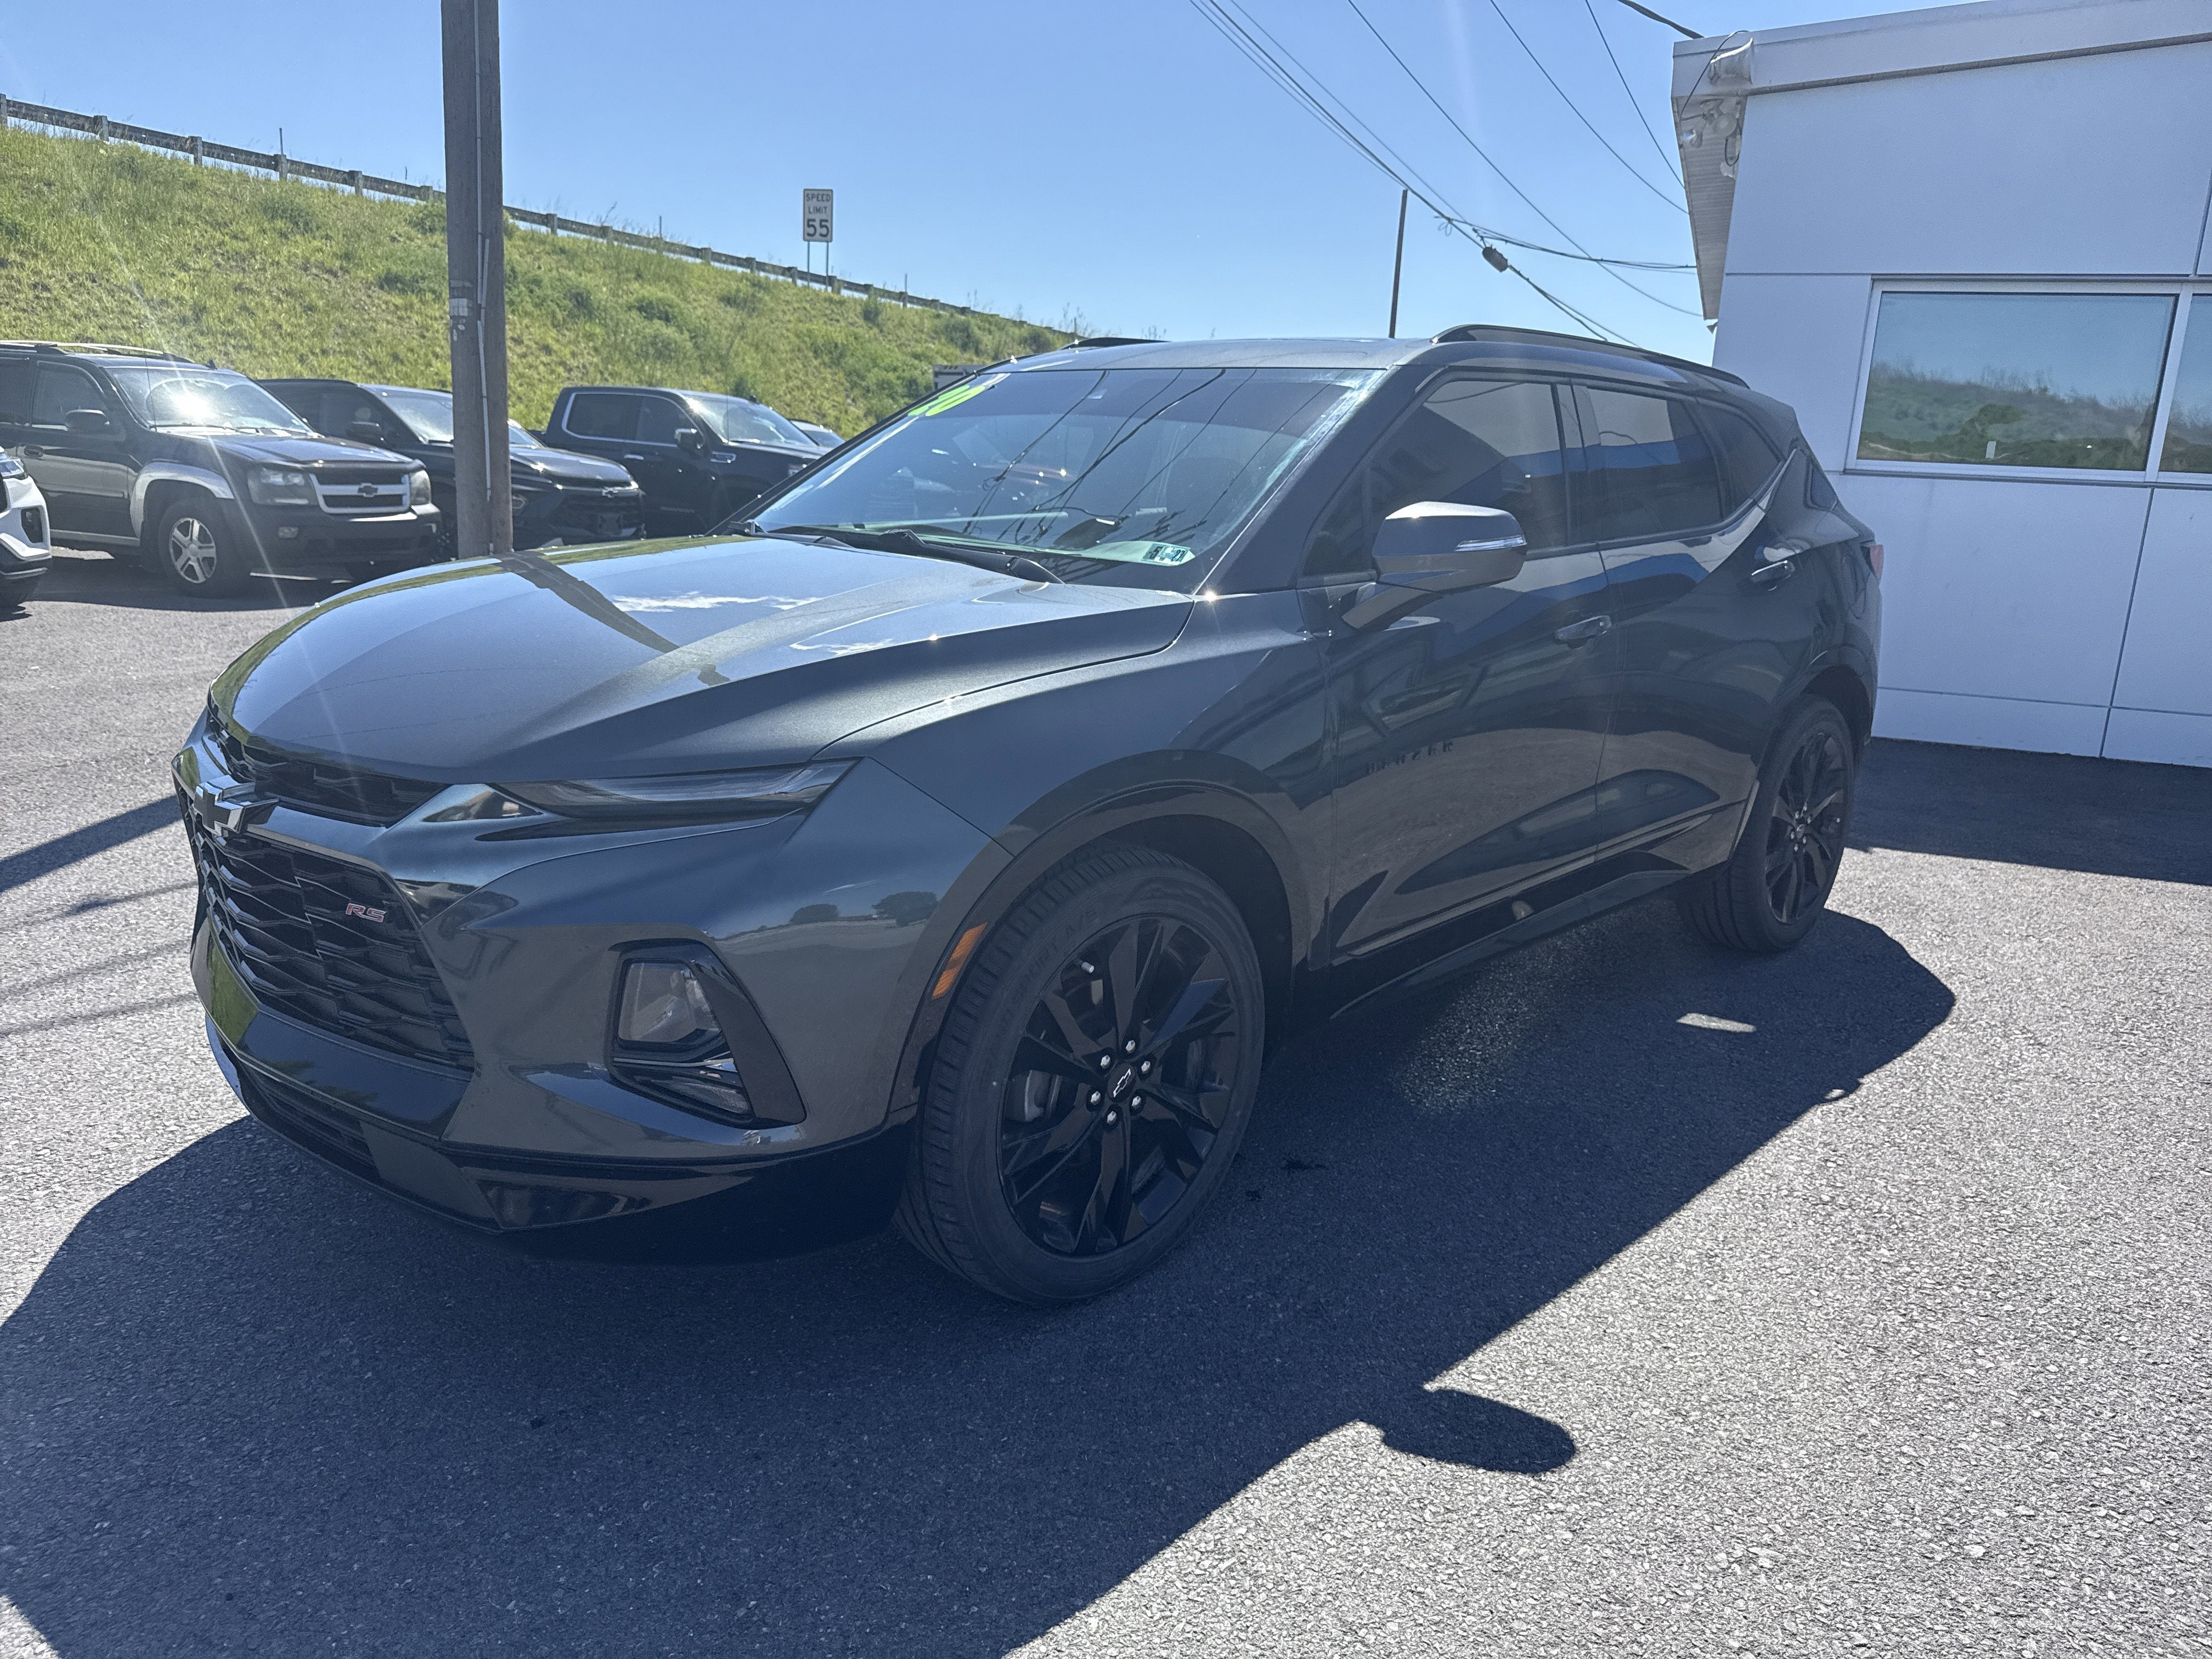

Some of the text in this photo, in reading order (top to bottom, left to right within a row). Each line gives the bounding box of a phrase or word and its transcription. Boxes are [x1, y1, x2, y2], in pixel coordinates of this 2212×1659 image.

[806, 193, 831, 202] SPEED
[806, 219, 830, 237] 55
[346, 902, 387, 922] RS
